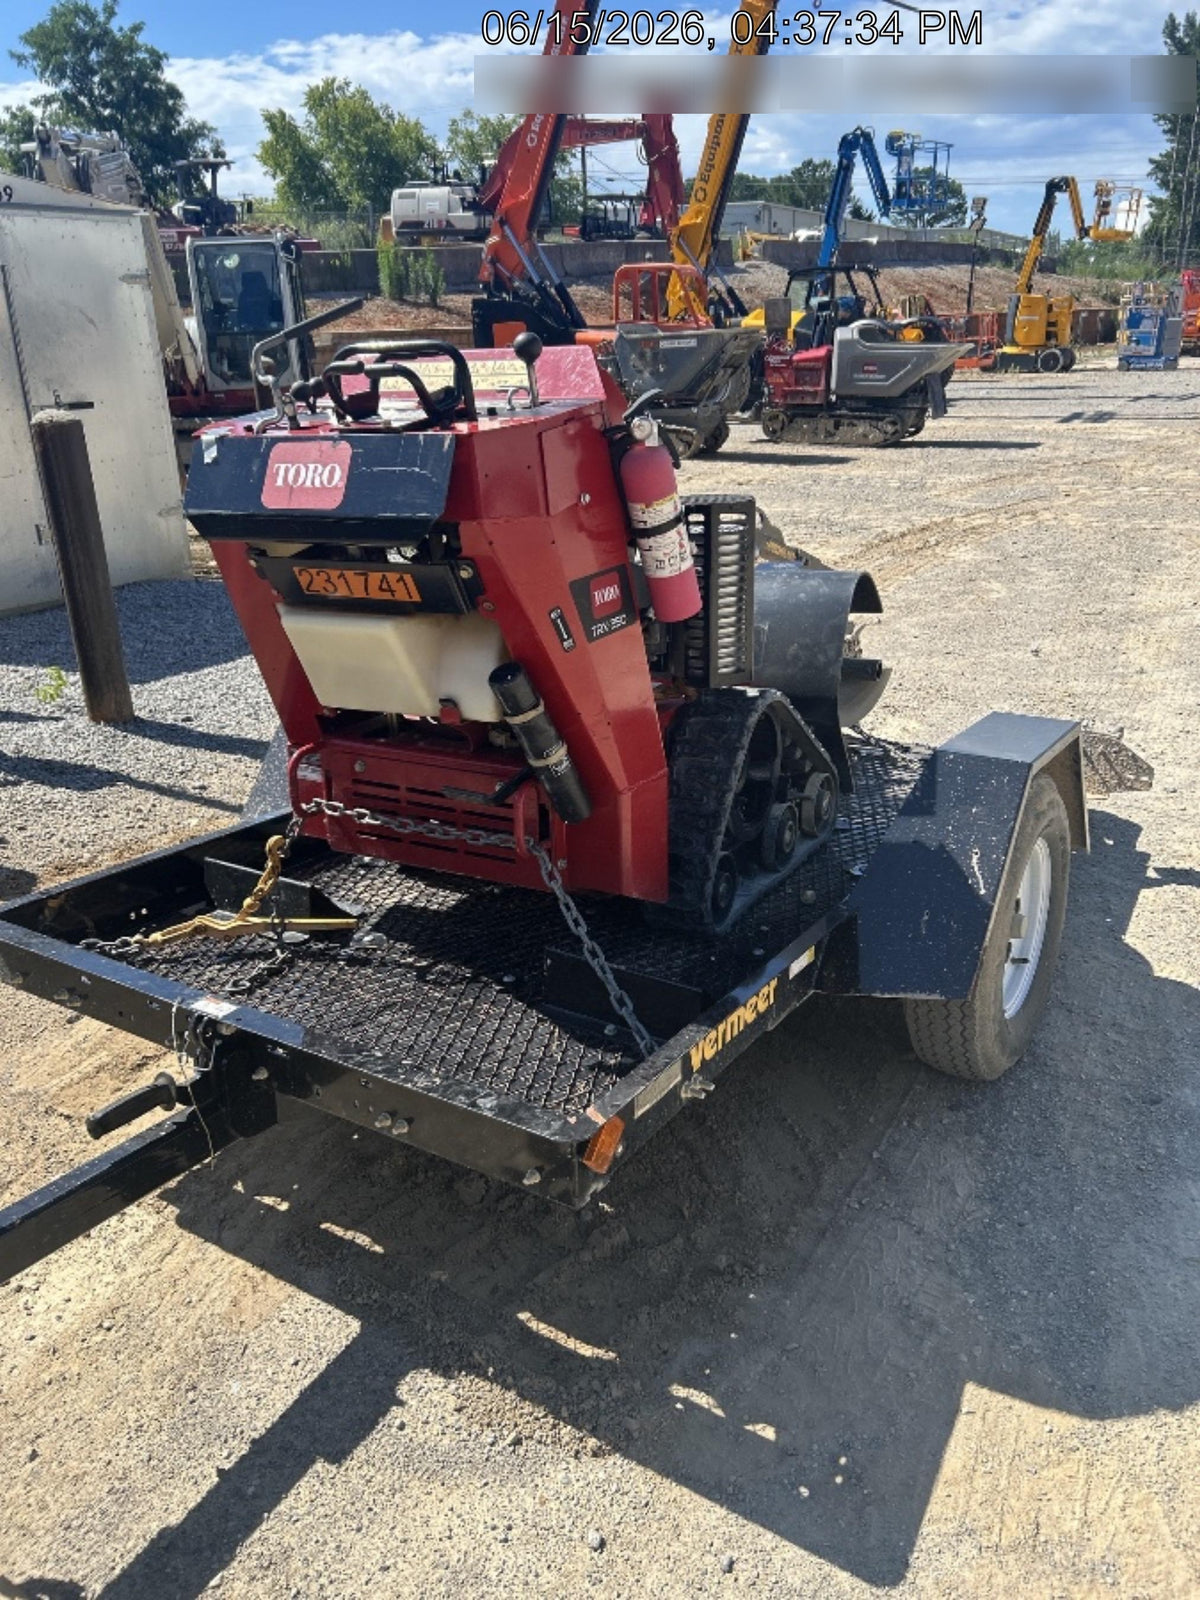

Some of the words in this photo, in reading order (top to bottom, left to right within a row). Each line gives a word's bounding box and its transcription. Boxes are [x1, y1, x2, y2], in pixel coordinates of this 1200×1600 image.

[272, 464, 343, 488] TORO
[298, 568, 414, 600] 231741
[593, 585, 621, 606] TORO
